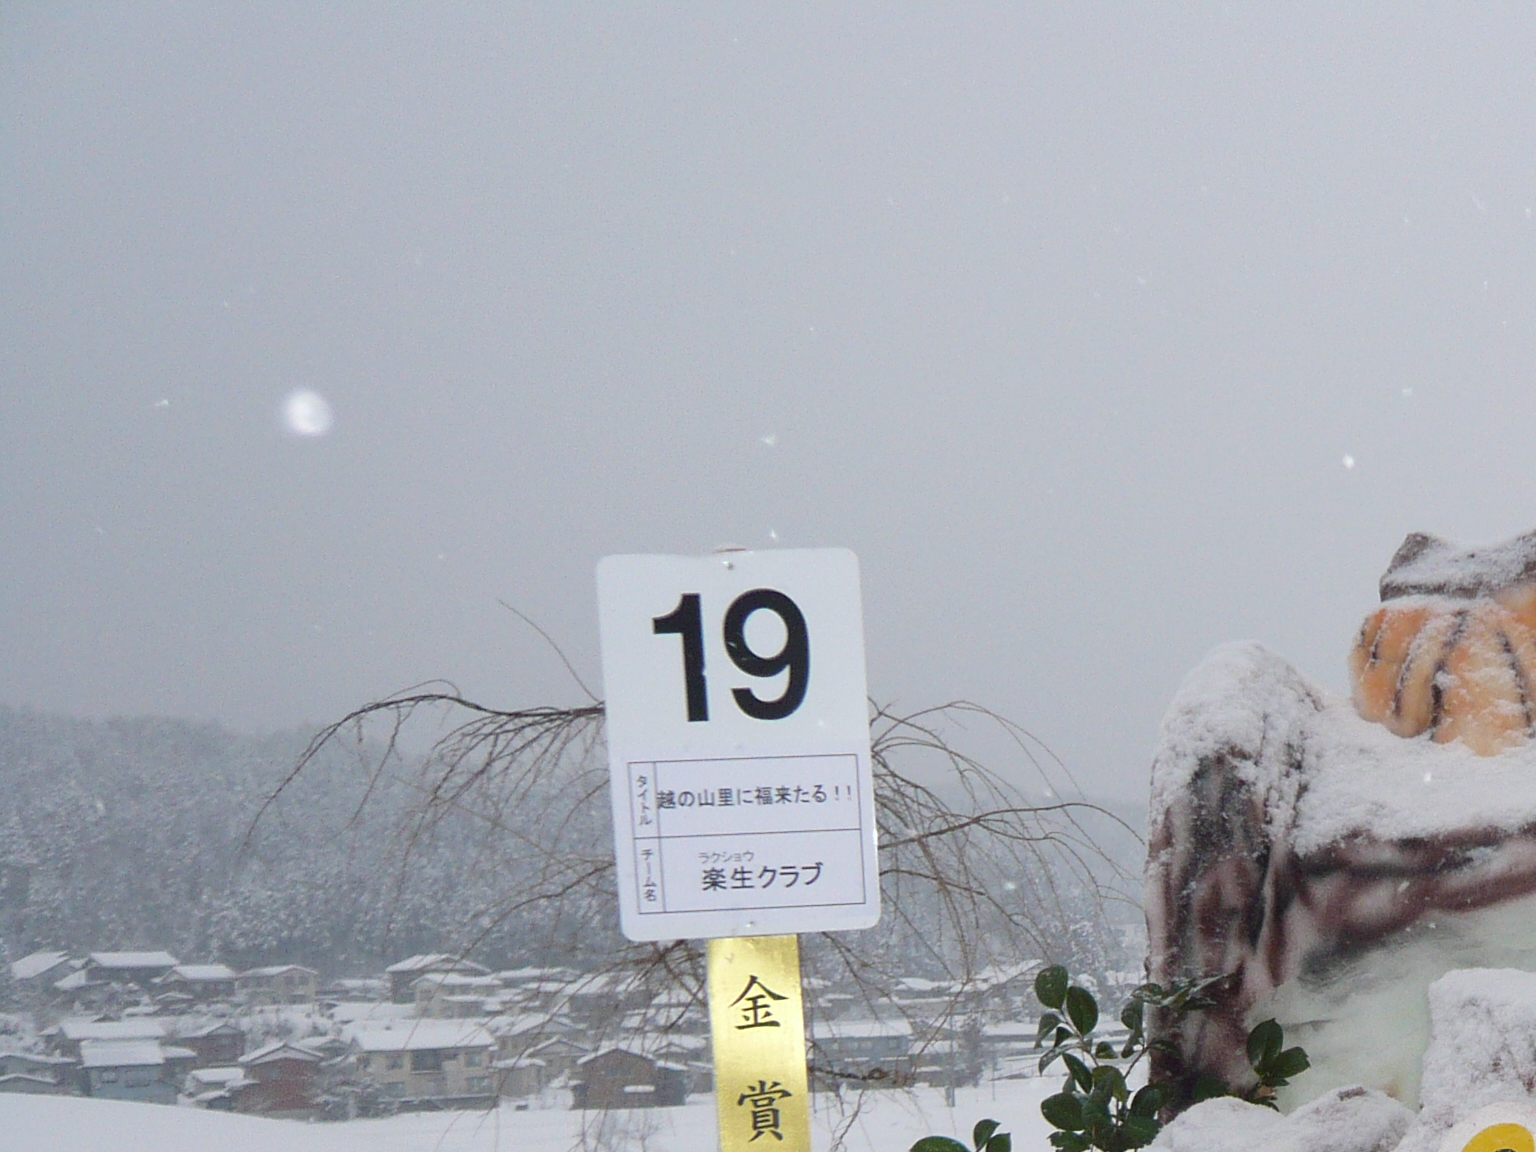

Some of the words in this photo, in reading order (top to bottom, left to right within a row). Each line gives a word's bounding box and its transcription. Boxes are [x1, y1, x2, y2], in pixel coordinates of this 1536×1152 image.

[652, 588, 810, 722] 19
[637, 775, 652, 826] タイトル
[640, 849, 657, 902] チーム名
[698, 850, 755, 864] ラクショウ
[701, 861, 824, 892] 楽生クラブ
[728, 974, 793, 1143] 金賞
